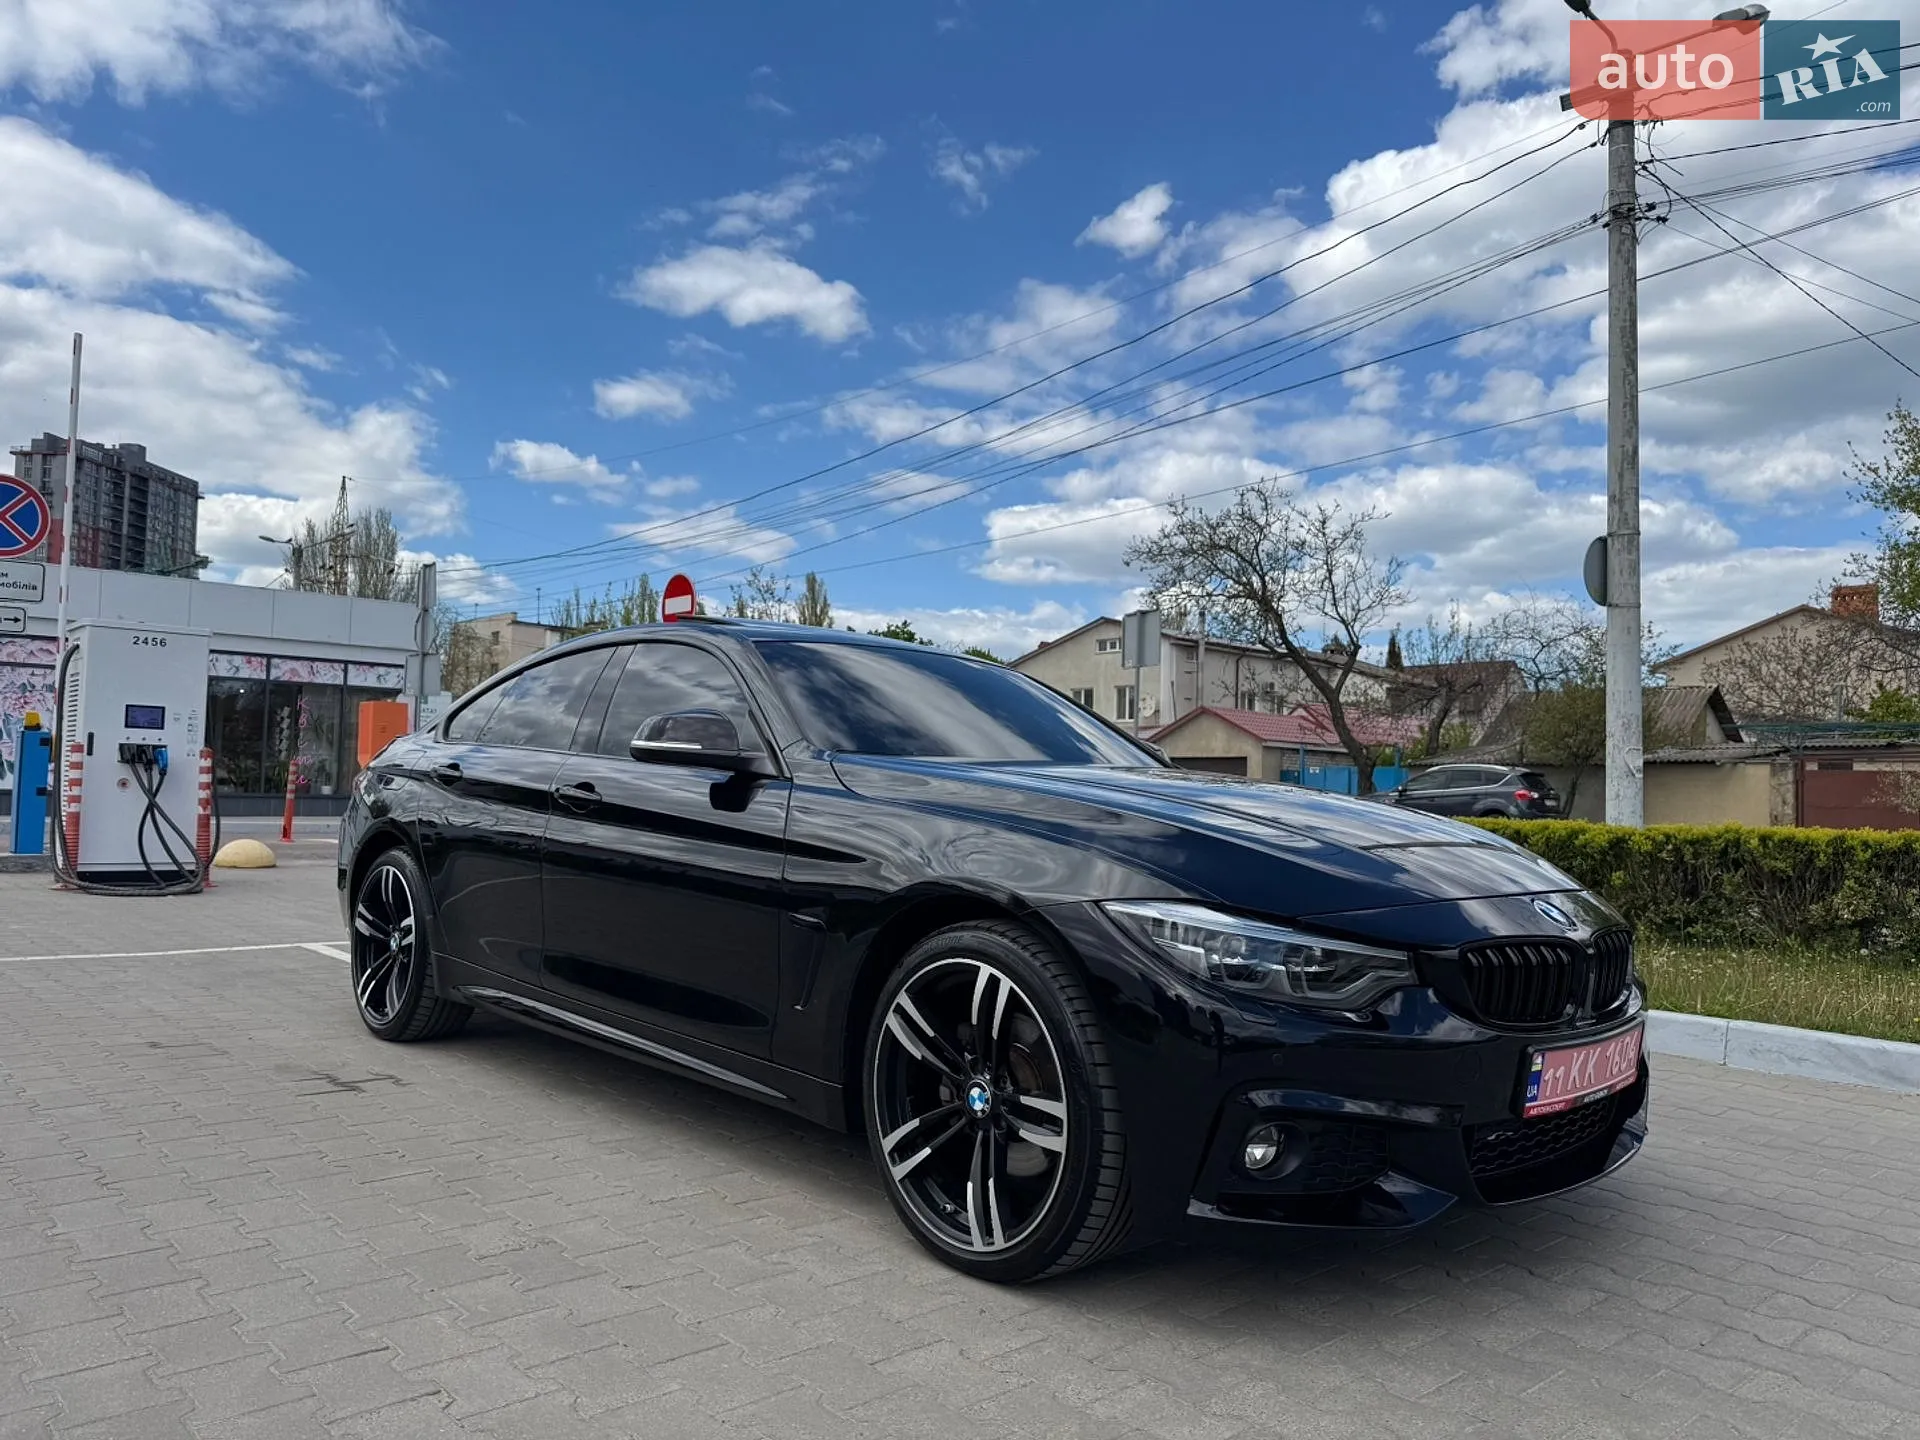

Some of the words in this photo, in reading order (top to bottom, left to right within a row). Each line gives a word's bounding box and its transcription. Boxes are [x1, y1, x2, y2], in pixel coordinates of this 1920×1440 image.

[132, 635, 167, 647] 2456
[1543, 1065, 1565, 1096] 11
[1526, 1085, 1537, 1097] UA
